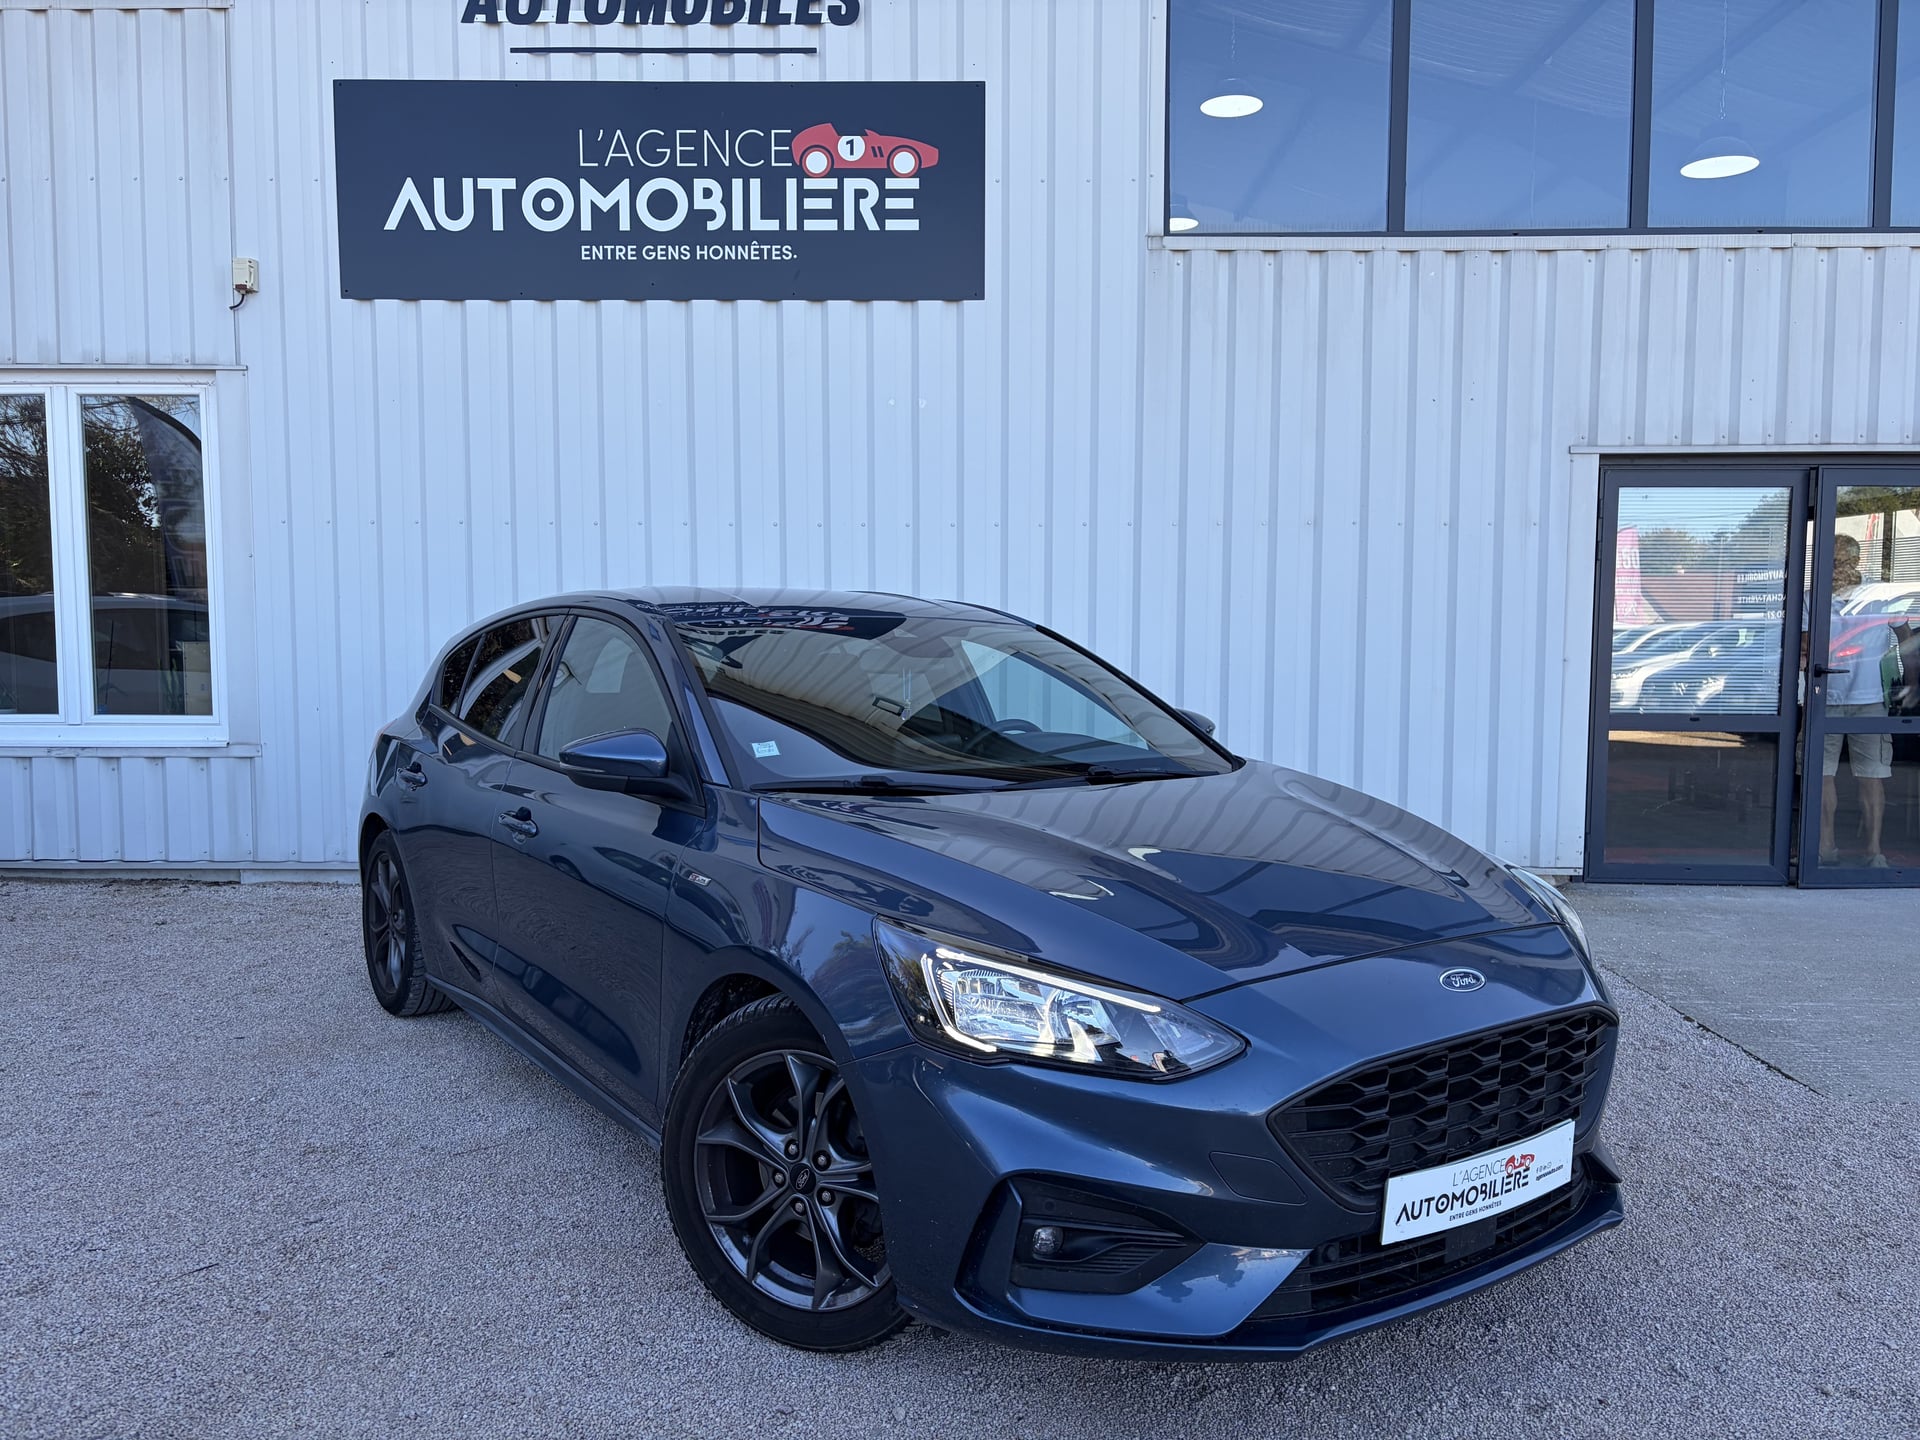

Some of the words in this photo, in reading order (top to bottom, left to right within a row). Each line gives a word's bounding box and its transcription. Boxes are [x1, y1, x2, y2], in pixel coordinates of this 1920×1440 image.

[578, 128, 792, 168] L'AGENCE
[581, 245, 638, 261] ENTRE
[642, 245, 691, 261] GENS
[696, 240, 798, 261] HONNÊTES.
[1449, 972, 1477, 988] Ford
[1453, 1158, 1507, 1187] L'AGENCE
[1449, 1211, 1465, 1222] ENTRE
[1465, 1207, 1479, 1218] GENS
